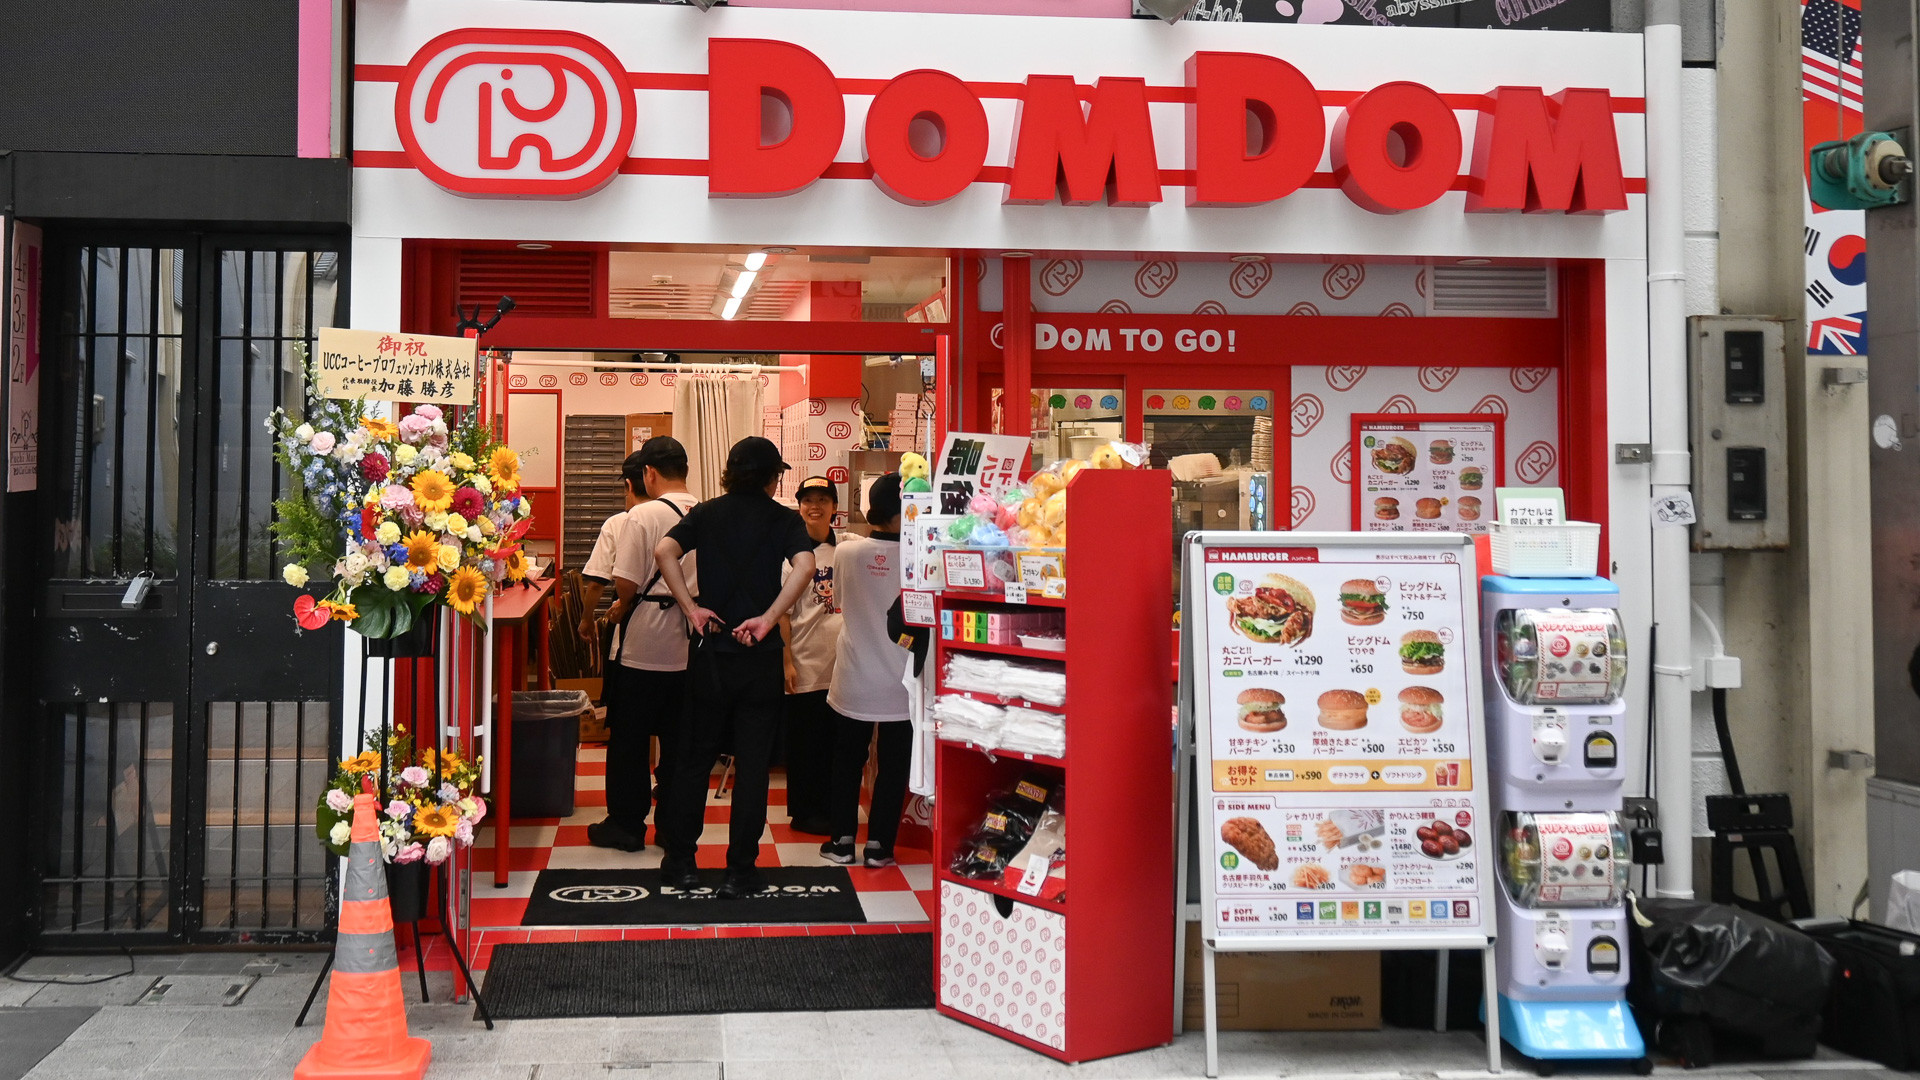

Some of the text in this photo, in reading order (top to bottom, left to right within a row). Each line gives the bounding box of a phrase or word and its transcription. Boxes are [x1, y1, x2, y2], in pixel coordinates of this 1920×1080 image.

[1035, 323, 1236, 353] DOM TO GO!
[377, 334, 428, 357] 御祝
[323, 351, 471, 380] UCCコーヒープロフェッショナル株式会社
[1221, 552, 1289, 561] HAMBURGER
[1399, 582, 1442, 591] ビッグドム
[1402, 611, 1425, 620] ¥750
[1347, 636, 1391, 646] ビッグドム
[1223, 656, 1282, 666] カニバーガー
[1350, 664, 1374, 674] ¥650
[1229, 747, 1260, 755] バーガー
[1272, 744, 1295, 753] ¥530
[1312, 747, 1344, 755] バーガー
[1362, 743, 1385, 753] ¥500
[1398, 747, 1429, 755] バーガー
[1433, 743, 1455, 753] ¥550
[1227, 765, 1258, 776] お得な
[1229, 776, 1257, 786] セット
